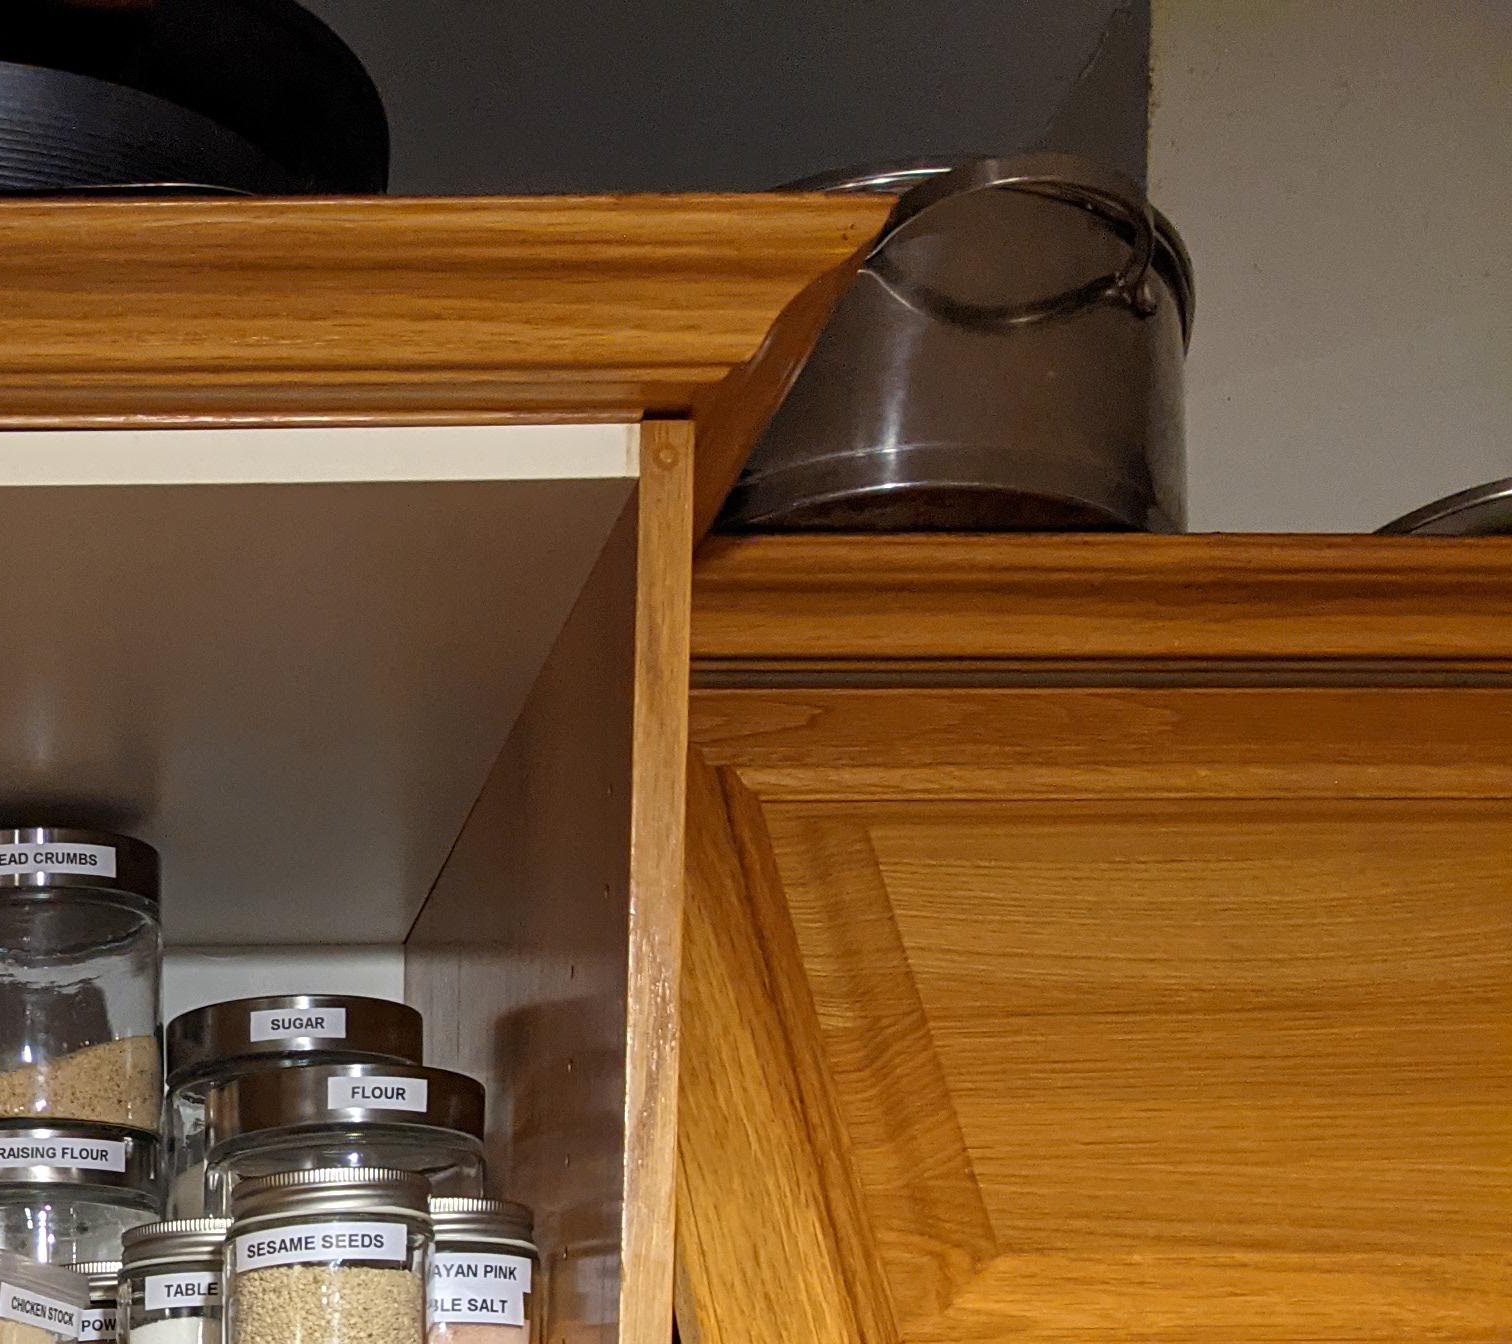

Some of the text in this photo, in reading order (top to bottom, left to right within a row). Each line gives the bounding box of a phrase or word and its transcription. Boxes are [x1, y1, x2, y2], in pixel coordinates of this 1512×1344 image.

[33, 852, 98, 867] CRUMBS
[271, 1016, 325, 1031] SUGAR
[351, 1086, 406, 1101] FLOUR
[61, 1146, 109, 1162] FLOUR
[247, 1234, 384, 1259] SESAME SEEDS
[432, 1264, 517, 1281] AYAN PINK
[164, 1282, 218, 1298] TABLE
[11, 1296, 75, 1327] CHICKEN STOCK
[433, 1298, 508, 1314] BLE SALT
[81, 1319, 116, 1333] POW
